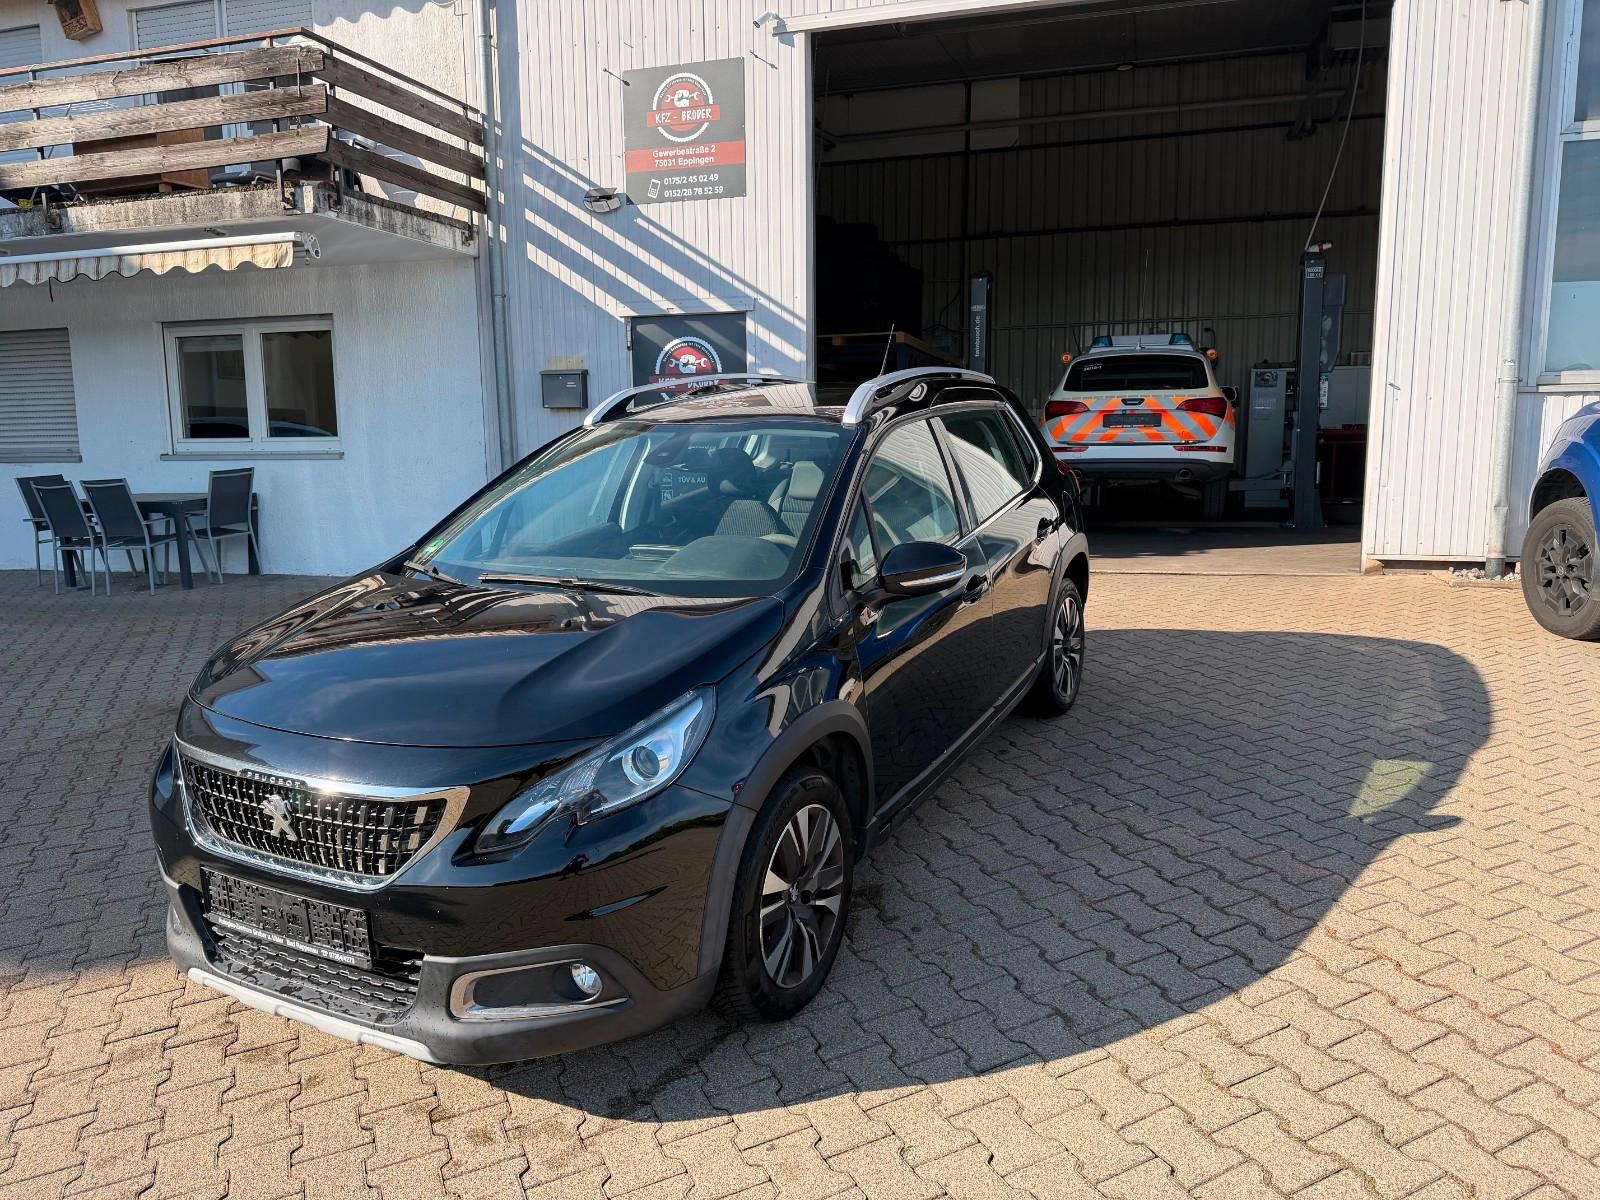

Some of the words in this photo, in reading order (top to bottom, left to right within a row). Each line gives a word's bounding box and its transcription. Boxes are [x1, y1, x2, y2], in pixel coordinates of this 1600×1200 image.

[655, 112, 671, 123] KFZ
[652, 145, 709, 158] Gewerbestraße
[710, 144, 716, 153] 2
[655, 159, 676, 168] 75031
[678, 156, 714, 167] Eppingen
[663, 176, 688, 185] 0175/2
[688, 175, 698, 183] 45
[698, 174, 708, 182] 02
[709, 173, 719, 182] 49
[664, 188, 692, 198] 0152/28
[693, 187, 703, 195] 78
[704, 186, 713, 195] 52
[714, 185, 724, 194] 59
[246, 771, 301, 788] PEUGEOT
